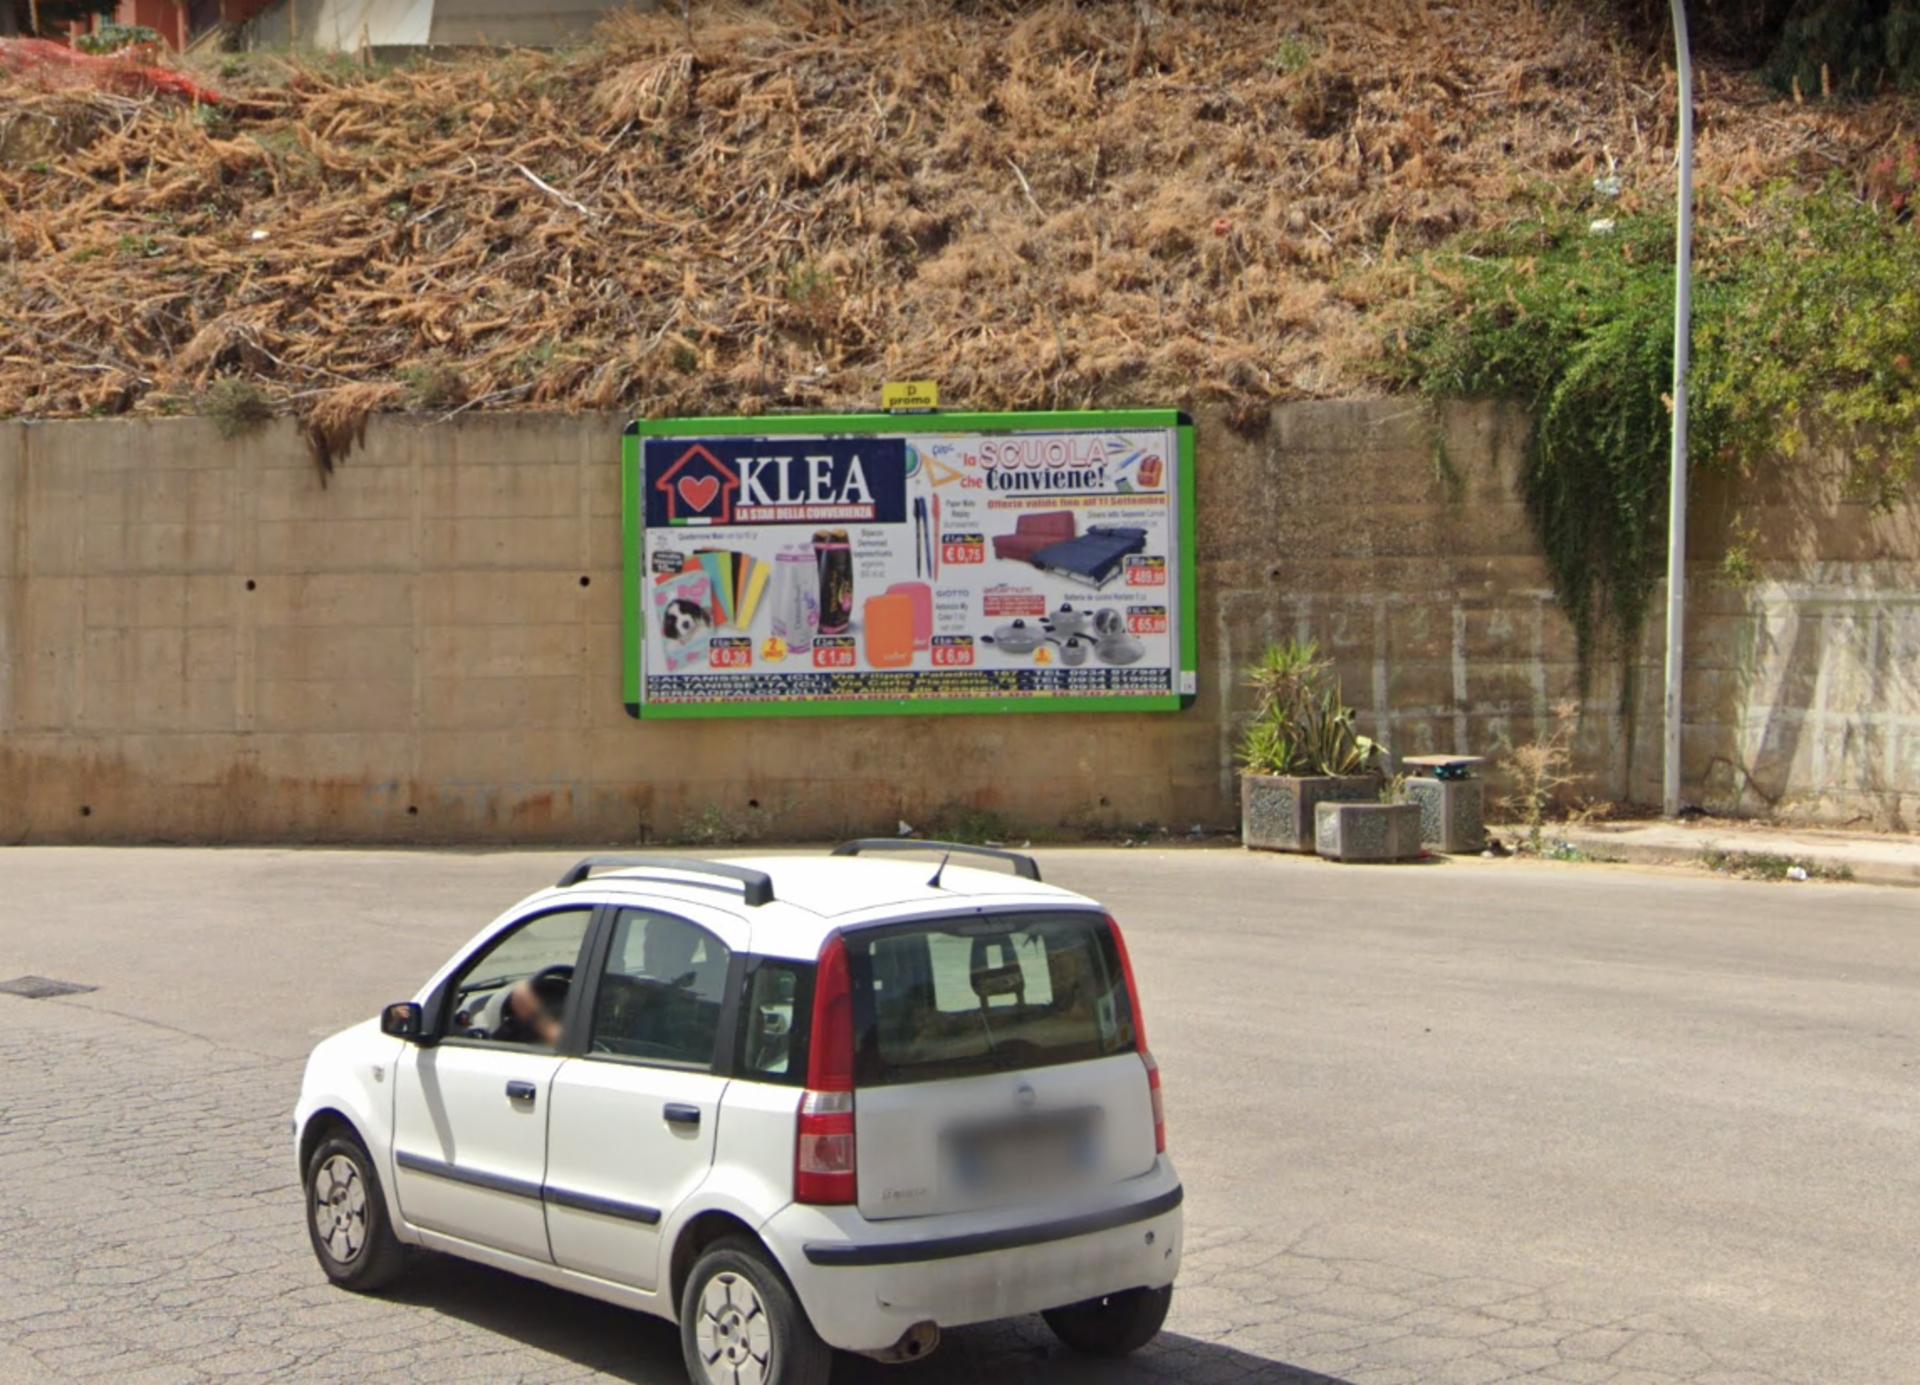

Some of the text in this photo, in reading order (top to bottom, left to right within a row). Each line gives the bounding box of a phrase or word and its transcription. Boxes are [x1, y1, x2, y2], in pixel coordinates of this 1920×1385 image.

[890, 396, 931, 406] promo
[980, 439, 1109, 470] SCUOLA
[735, 454, 876, 506] KLEA
[960, 466, 1104, 491] che Conviene!
[1110, 496, 1166, 506] Settembre
[736, 509, 749, 521] LA
[806, 505, 873, 519] CONVENIENZA
[649, 674, 782, 682] CALTANISSETTA
[648, 682, 787, 690] CALTANISSETTA
[650, 689, 780, 697] SERRADIFALCO
